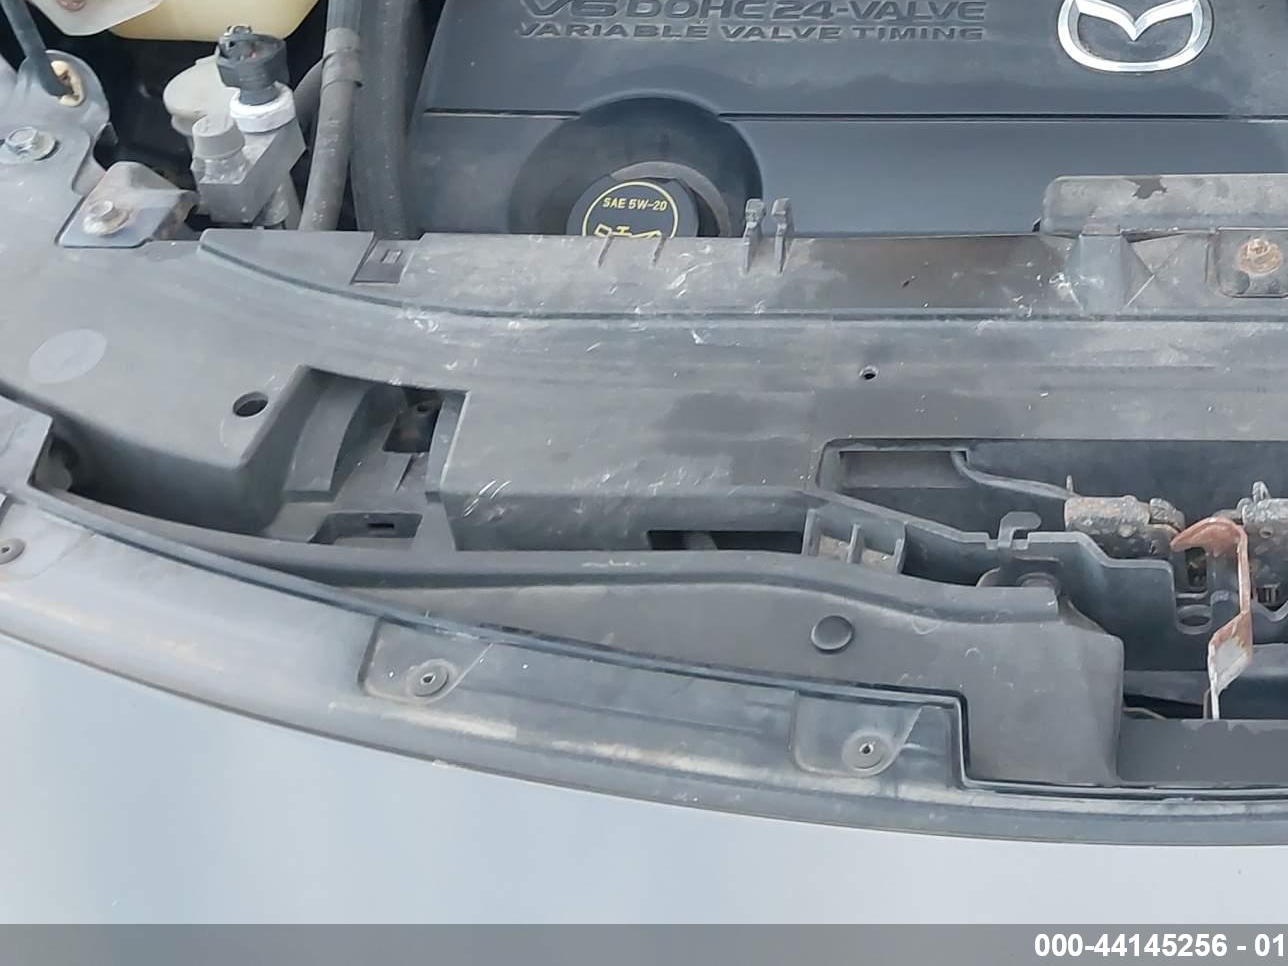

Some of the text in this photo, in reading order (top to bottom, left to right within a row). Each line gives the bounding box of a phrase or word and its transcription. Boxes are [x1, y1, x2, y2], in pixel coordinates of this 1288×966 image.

[771, 0, 987, 21] 24-VALVE
[519, 22, 983, 41] VARIABLE VALVE TIMING
[602, 197, 668, 211] SAE 5W-20
